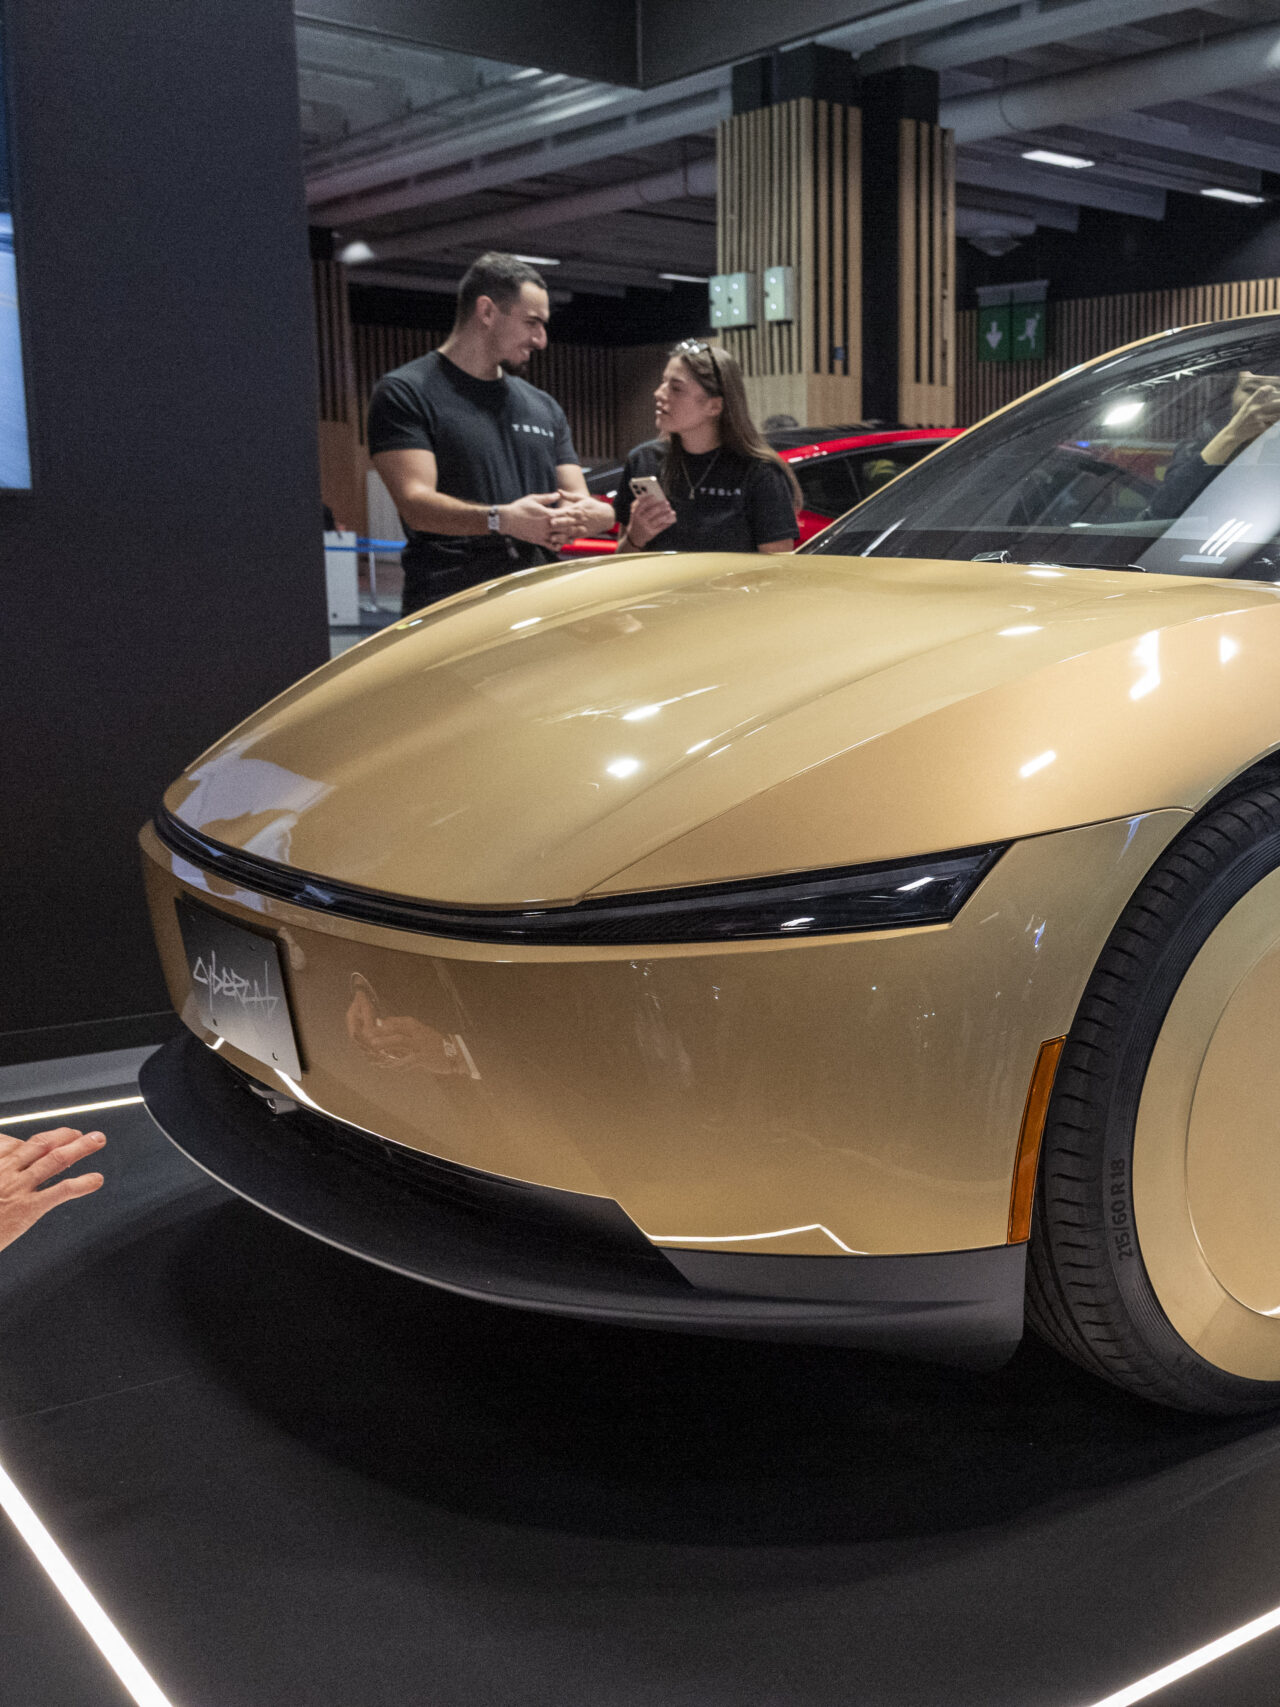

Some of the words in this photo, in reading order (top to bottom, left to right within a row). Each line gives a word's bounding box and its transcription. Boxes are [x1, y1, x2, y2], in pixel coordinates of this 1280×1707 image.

[1110, 1158, 1126, 1179] 18
[1110, 1180, 1126, 1196] R
[1111, 1200, 1134, 1261] 215/60
